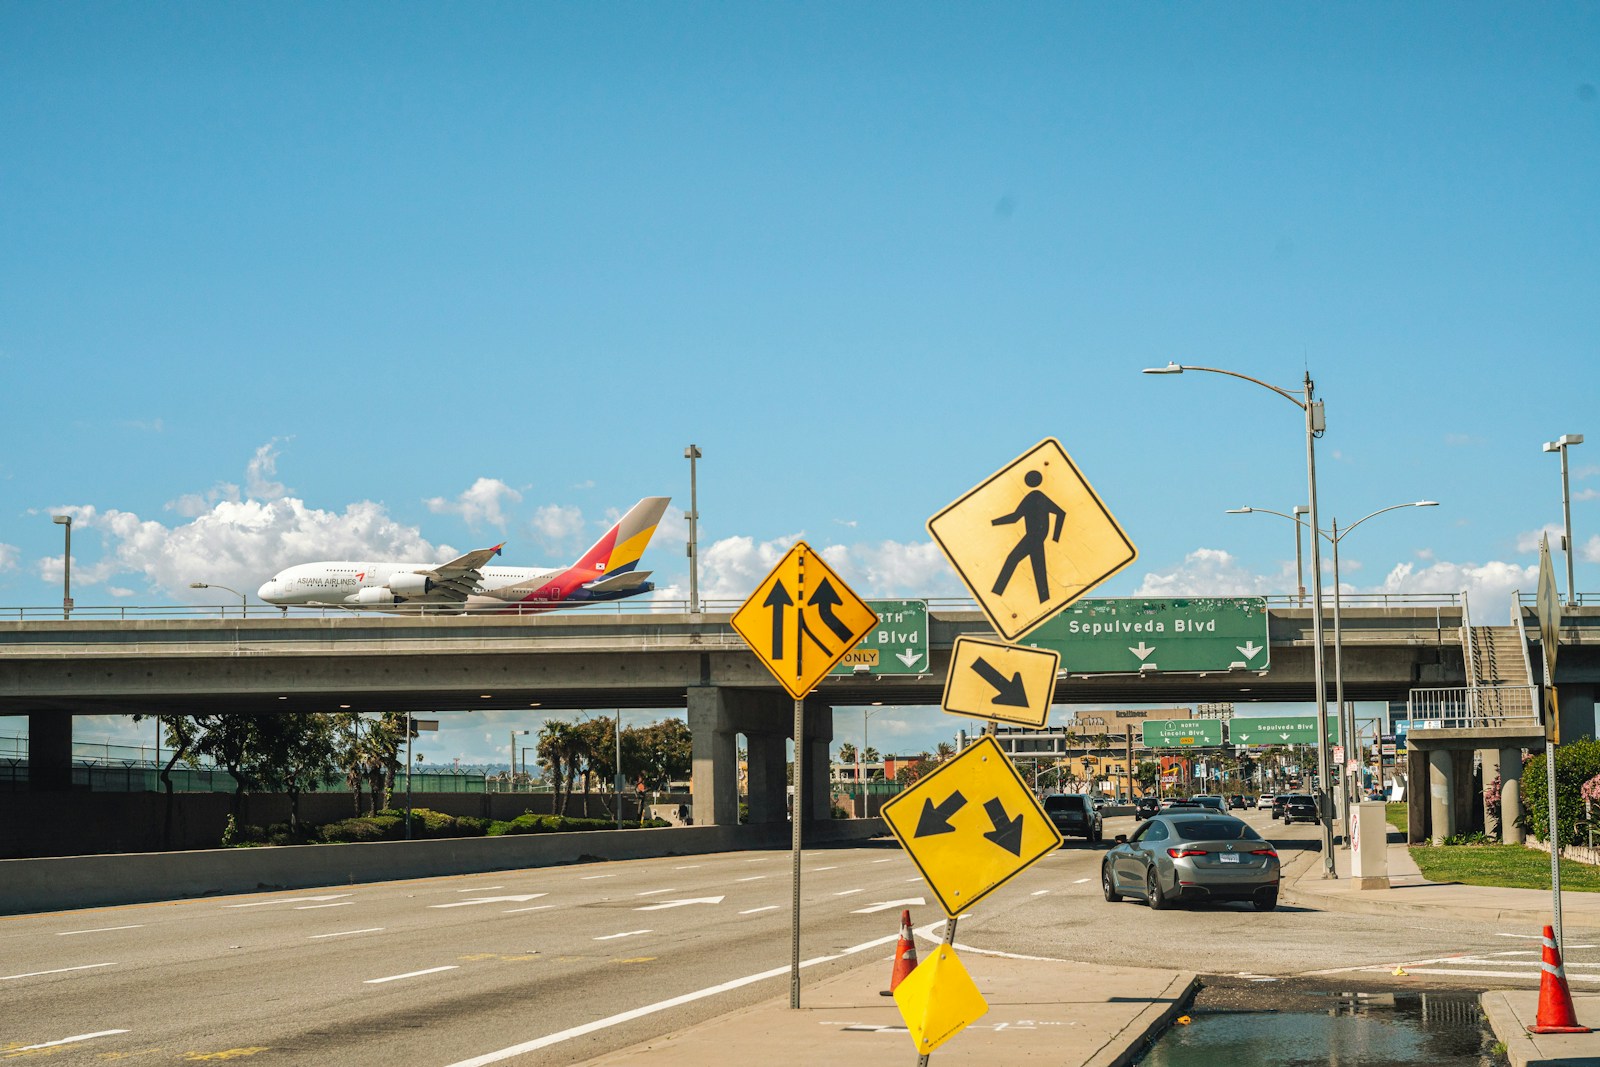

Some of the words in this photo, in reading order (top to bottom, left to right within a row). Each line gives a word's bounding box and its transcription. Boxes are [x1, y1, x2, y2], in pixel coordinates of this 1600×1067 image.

[324, 578, 357, 586] AIRLINES
[877, 613, 903, 623] RTH
[1069, 619, 1165, 635] Sepulveda
[1174, 619, 1216, 632] Blvd
[878, 630, 918, 643] Blvd
[844, 653, 877, 663] ONLY
